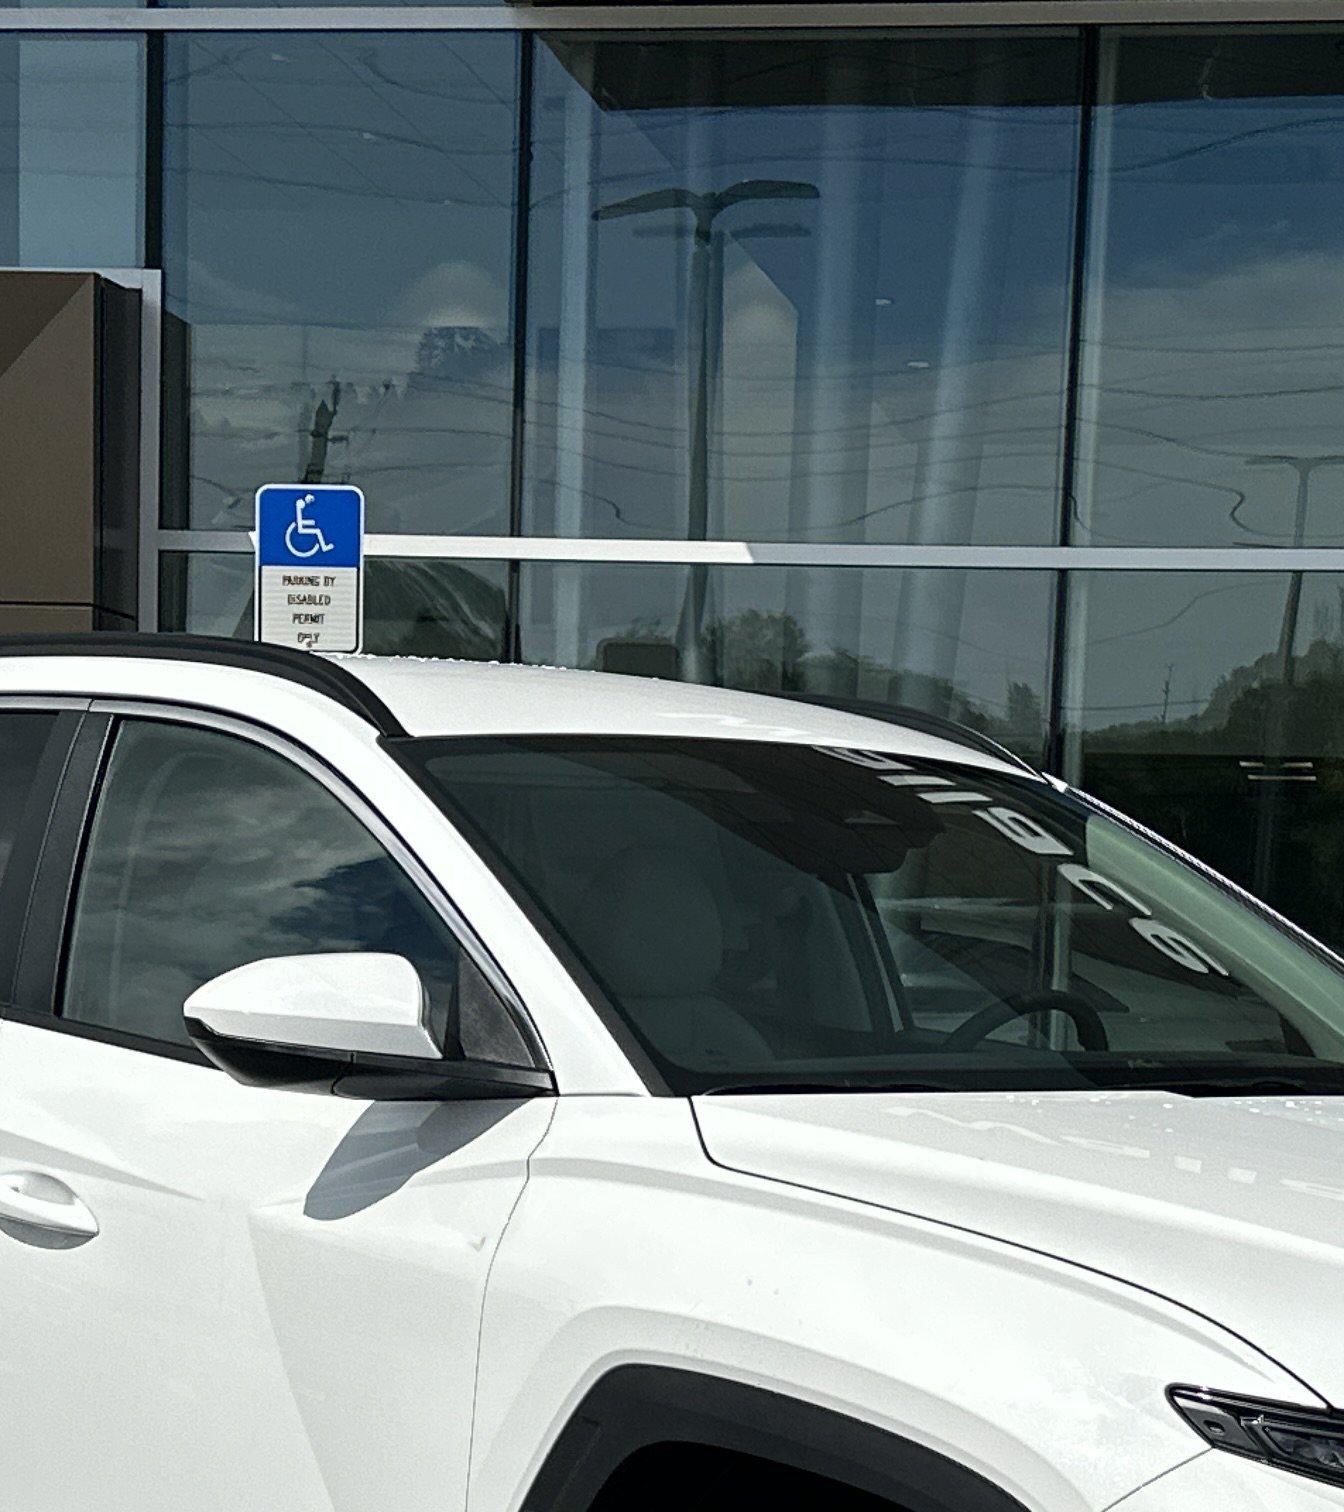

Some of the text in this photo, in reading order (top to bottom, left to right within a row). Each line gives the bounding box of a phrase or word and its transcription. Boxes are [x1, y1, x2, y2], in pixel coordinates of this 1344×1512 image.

[282, 575, 336, 587] PARKING BY
[287, 594, 331, 606] DISABLED
[292, 613, 325, 624] PERMIT
